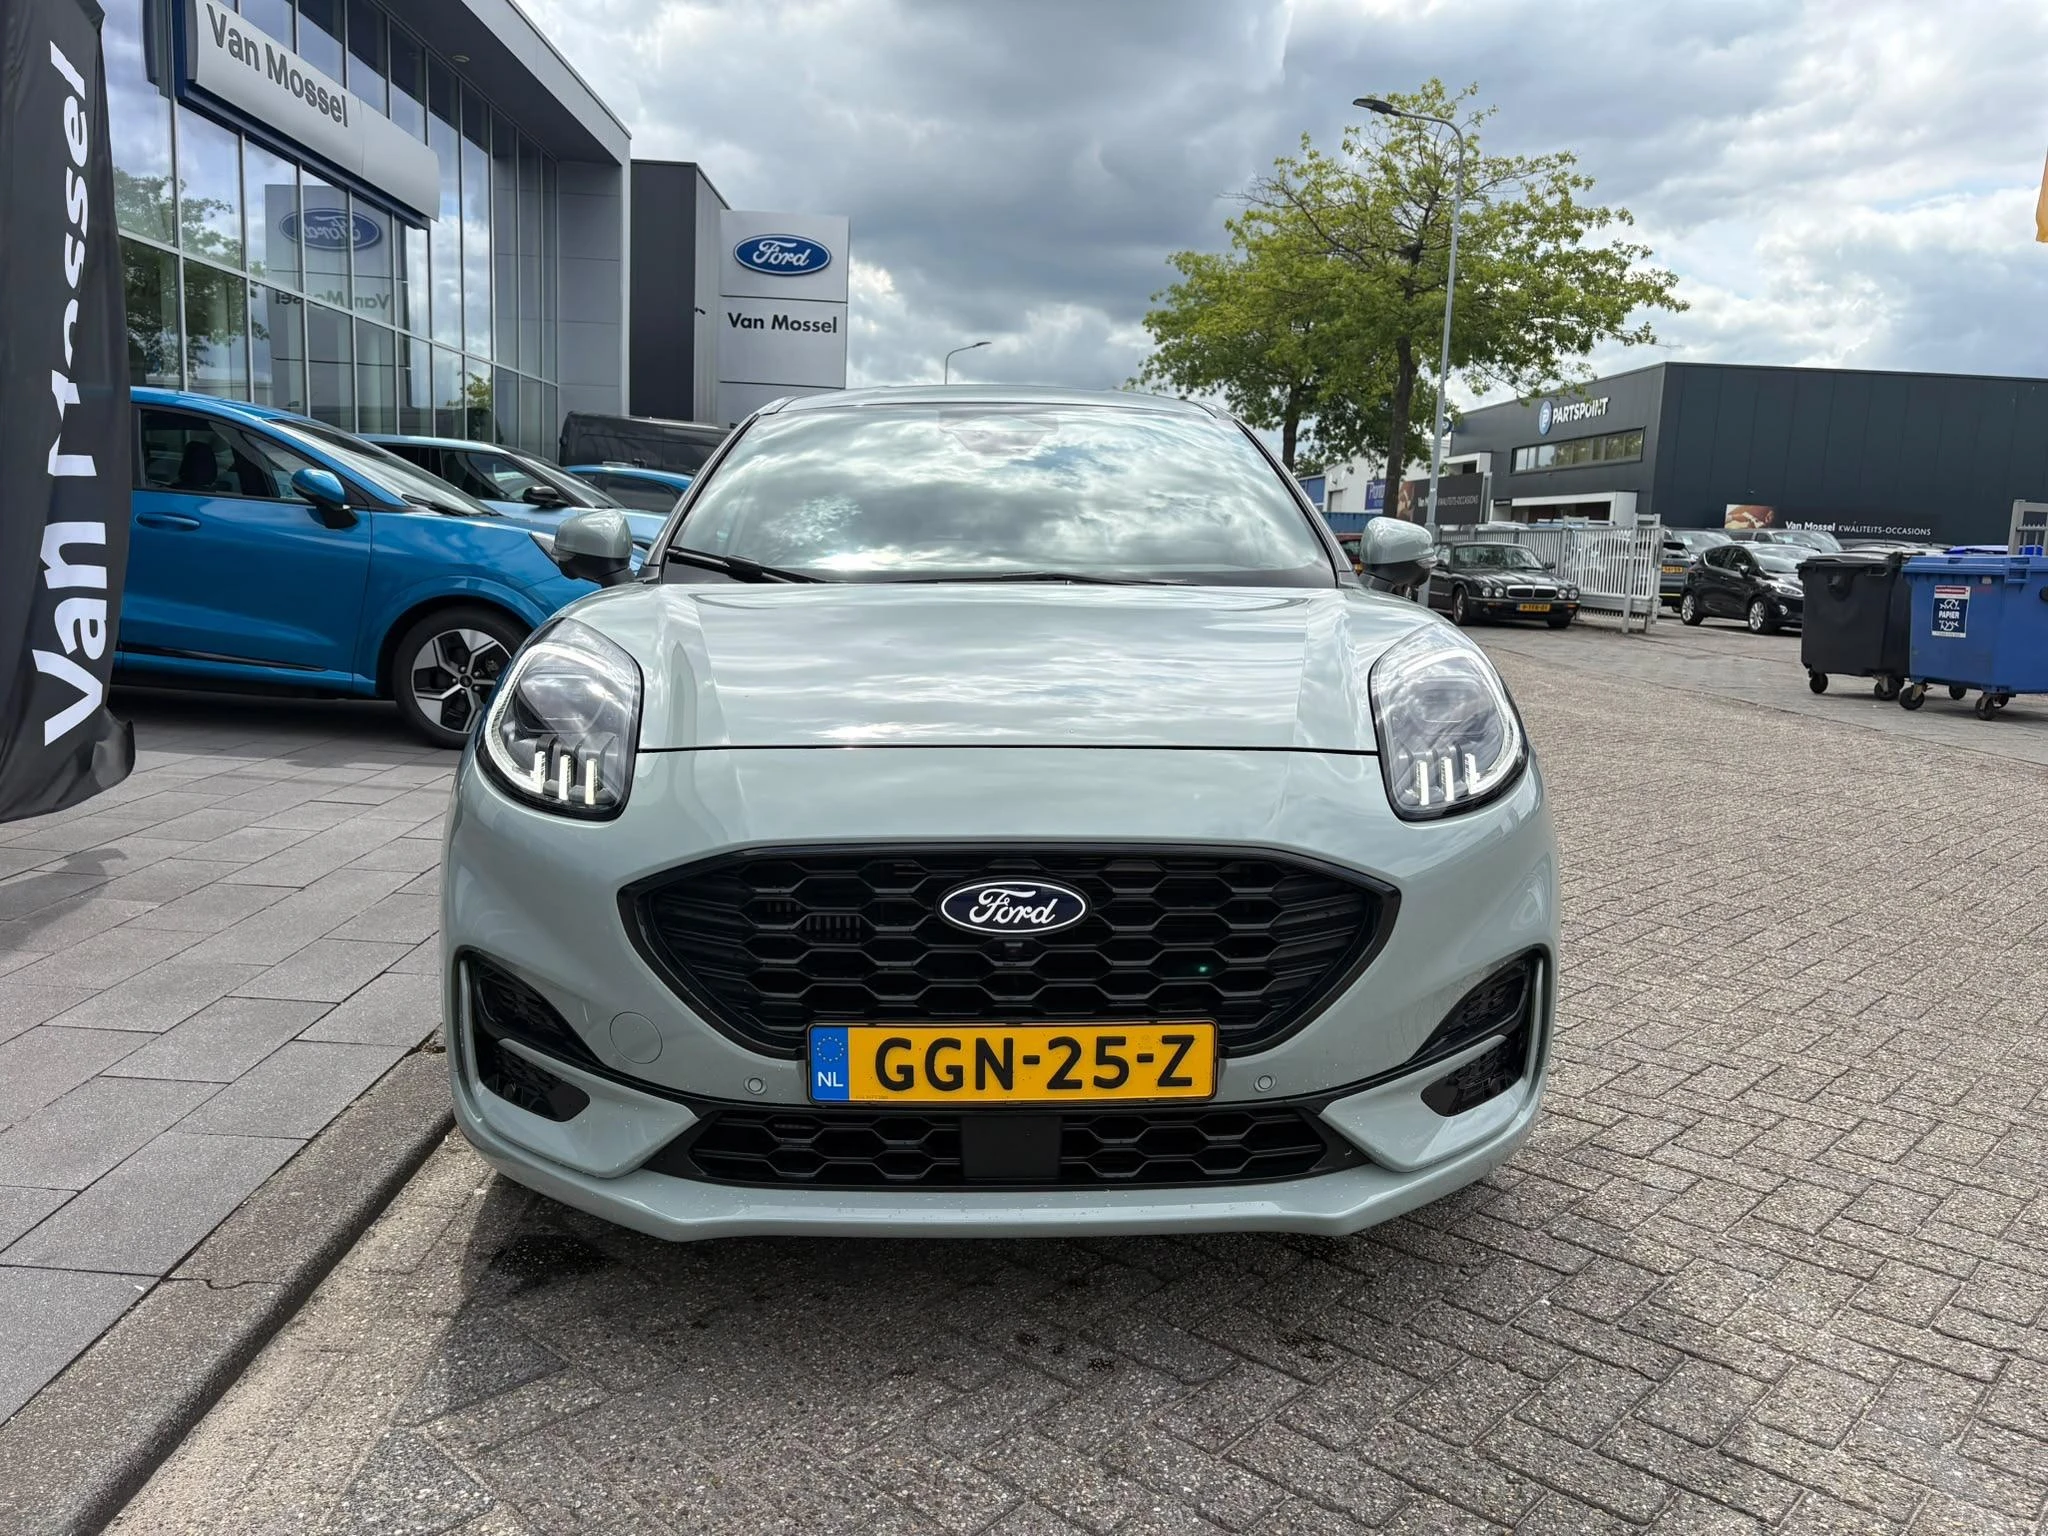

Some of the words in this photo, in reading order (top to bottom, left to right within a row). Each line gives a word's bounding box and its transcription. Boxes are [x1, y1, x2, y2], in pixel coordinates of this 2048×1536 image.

[206, 3, 260, 71] Van
[265, 43, 348, 127] Mossel
[752, 240, 811, 267] Ford
[727, 312, 764, 330] Van
[771, 314, 837, 333] Mossel
[1552, 397, 1609, 424] PARTSPOINT
[1785, 521, 1802, 530] Van
[1804, 521, 1836, 532] Mossel
[1838, 524, 1931, 536] KWALITEITS-OCCASIONS
[1938, 610, 1960, 619] PAPIER
[32, 521, 107, 746] Van
[968, 888, 1058, 925] Ford
[817, 1071, 844, 1088] NL
[874, 1034, 1195, 1092] GGN-25-Z
